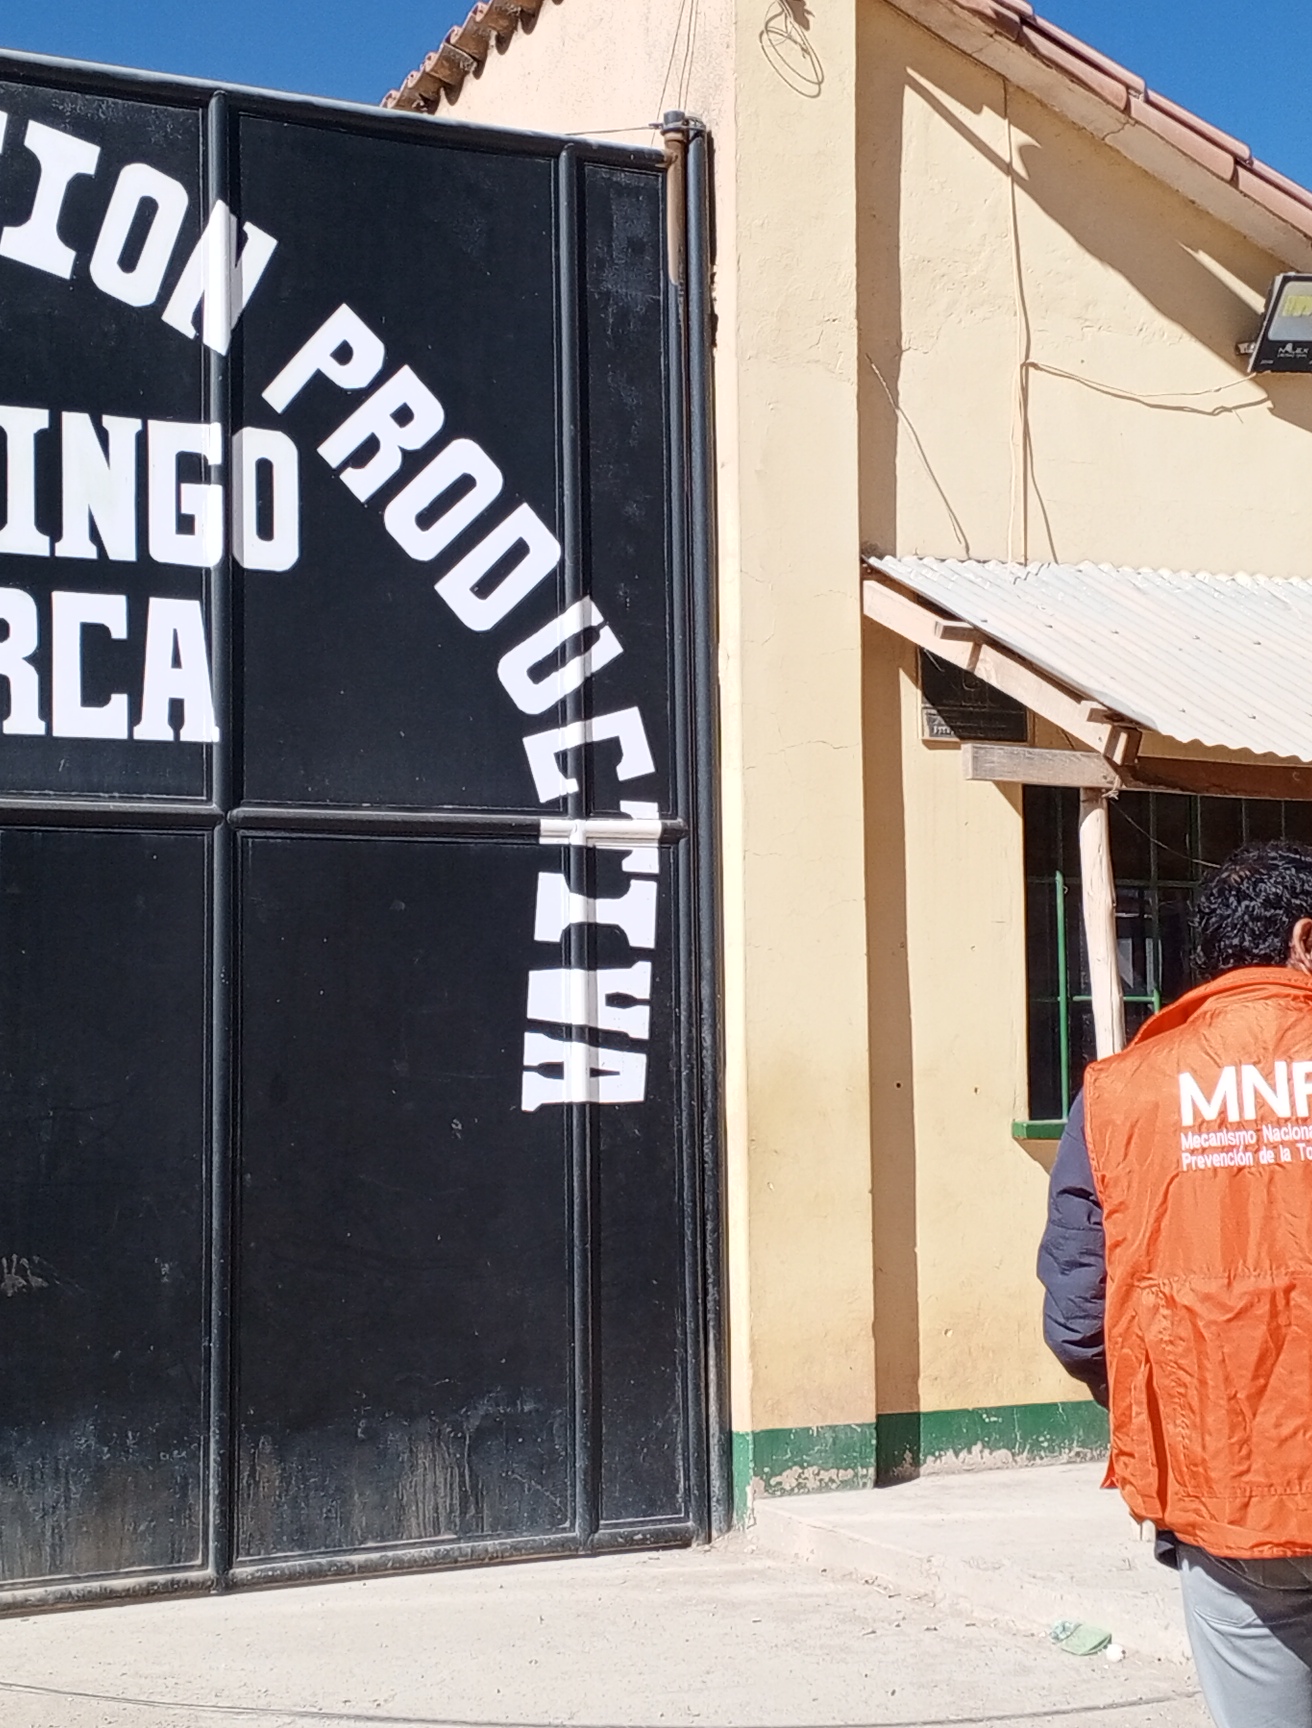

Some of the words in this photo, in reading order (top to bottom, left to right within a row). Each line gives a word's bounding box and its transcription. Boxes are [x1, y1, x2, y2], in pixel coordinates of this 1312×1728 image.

[261, 303, 665, 1112] PRODUCTIVA
[1180, 1129, 1257, 1150] Mecanismo
[1182, 1145, 1254, 1171] Prevención
[1259, 1148, 1275, 1164] de
[1280, 1145, 1292, 1163] la
